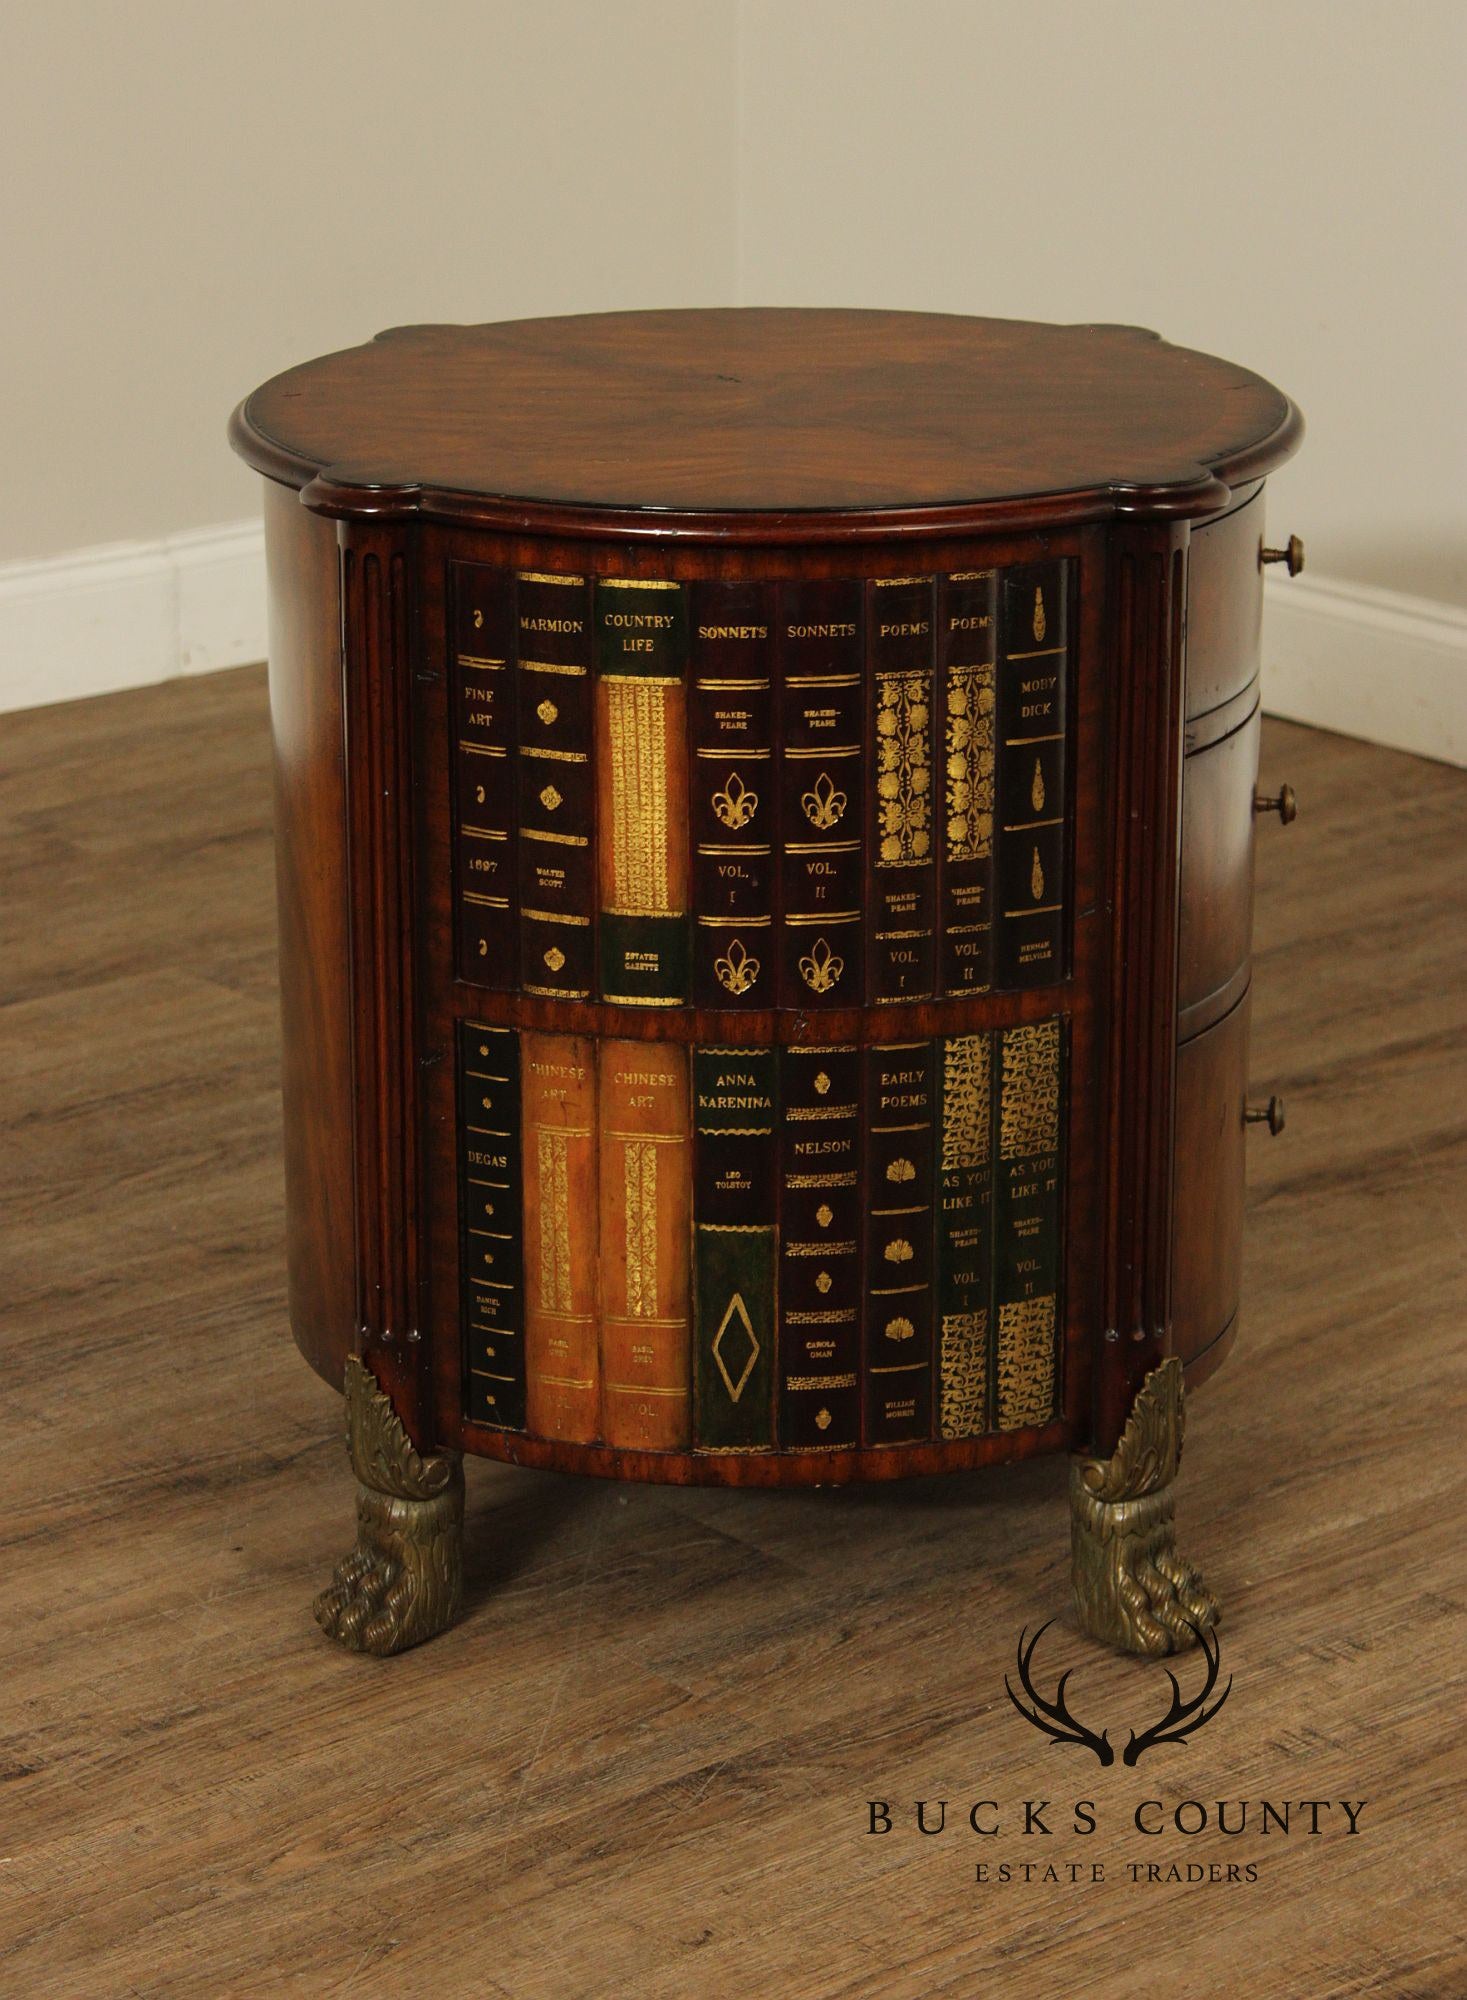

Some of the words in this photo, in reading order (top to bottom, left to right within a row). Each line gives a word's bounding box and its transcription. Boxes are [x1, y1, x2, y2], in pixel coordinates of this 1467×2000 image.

[521, 617, 583, 633] MARMION
[604, 614, 675, 629] COUNTRY
[950, 616, 993, 630] POEMS
[699, 626, 768, 639] SONNETS
[788, 624, 856, 638] SONNETS
[880, 622, 929, 637] POEMS
[623, 640, 654, 652] LIFE
[1022, 677, 1056, 693] MOBY
[465, 687, 494, 702] FINE
[1022, 703, 1051, 718] DICK
[469, 714, 492, 726] ART
[720, 722, 747, 730] PEARE
[469, 860, 498, 873] 1897
[536, 868, 565, 878] WALTER
[718, 866, 749, 878] VOL.
[807, 862, 837, 875] VOL.
[730, 890, 736, 904] I
[815, 886, 826, 899] II
[890, 951, 919, 963] VOL.
[964, 968, 974, 980] II
[900, 976, 905, 988] I
[614, 1072, 676, 1087] CHINESE
[716, 1074, 756, 1087] ANNA
[881, 1070, 925, 1086] EARLY
[541, 1089, 567, 1101] ART
[881, 1094, 928, 1109] POEMS
[628, 1096, 655, 1108] ART
[698, 1095, 772, 1109] KARENINA
[794, 1140, 851, 1155] NELSON
[467, 1151, 507, 1168] DEGAS
[1010, 1164, 1025, 1178] AS
[1031, 1158, 1055, 1174] YOU
[726, 1171, 741, 1179] LEO
[943, 1174, 960, 1188] AS
[967, 1170, 990, 1186] YOU
[716, 1181, 752, 1190] TOLSTOY
[1012, 1184, 1038, 1199] LIKE
[1045, 1178, 1057, 1192] IT
[943, 1195, 973, 1210] LIKE
[1025, 1282, 1033, 1295] II
[806, 1340, 836, 1349] CAROLA
[810, 1350, 833, 1359] OMAN
